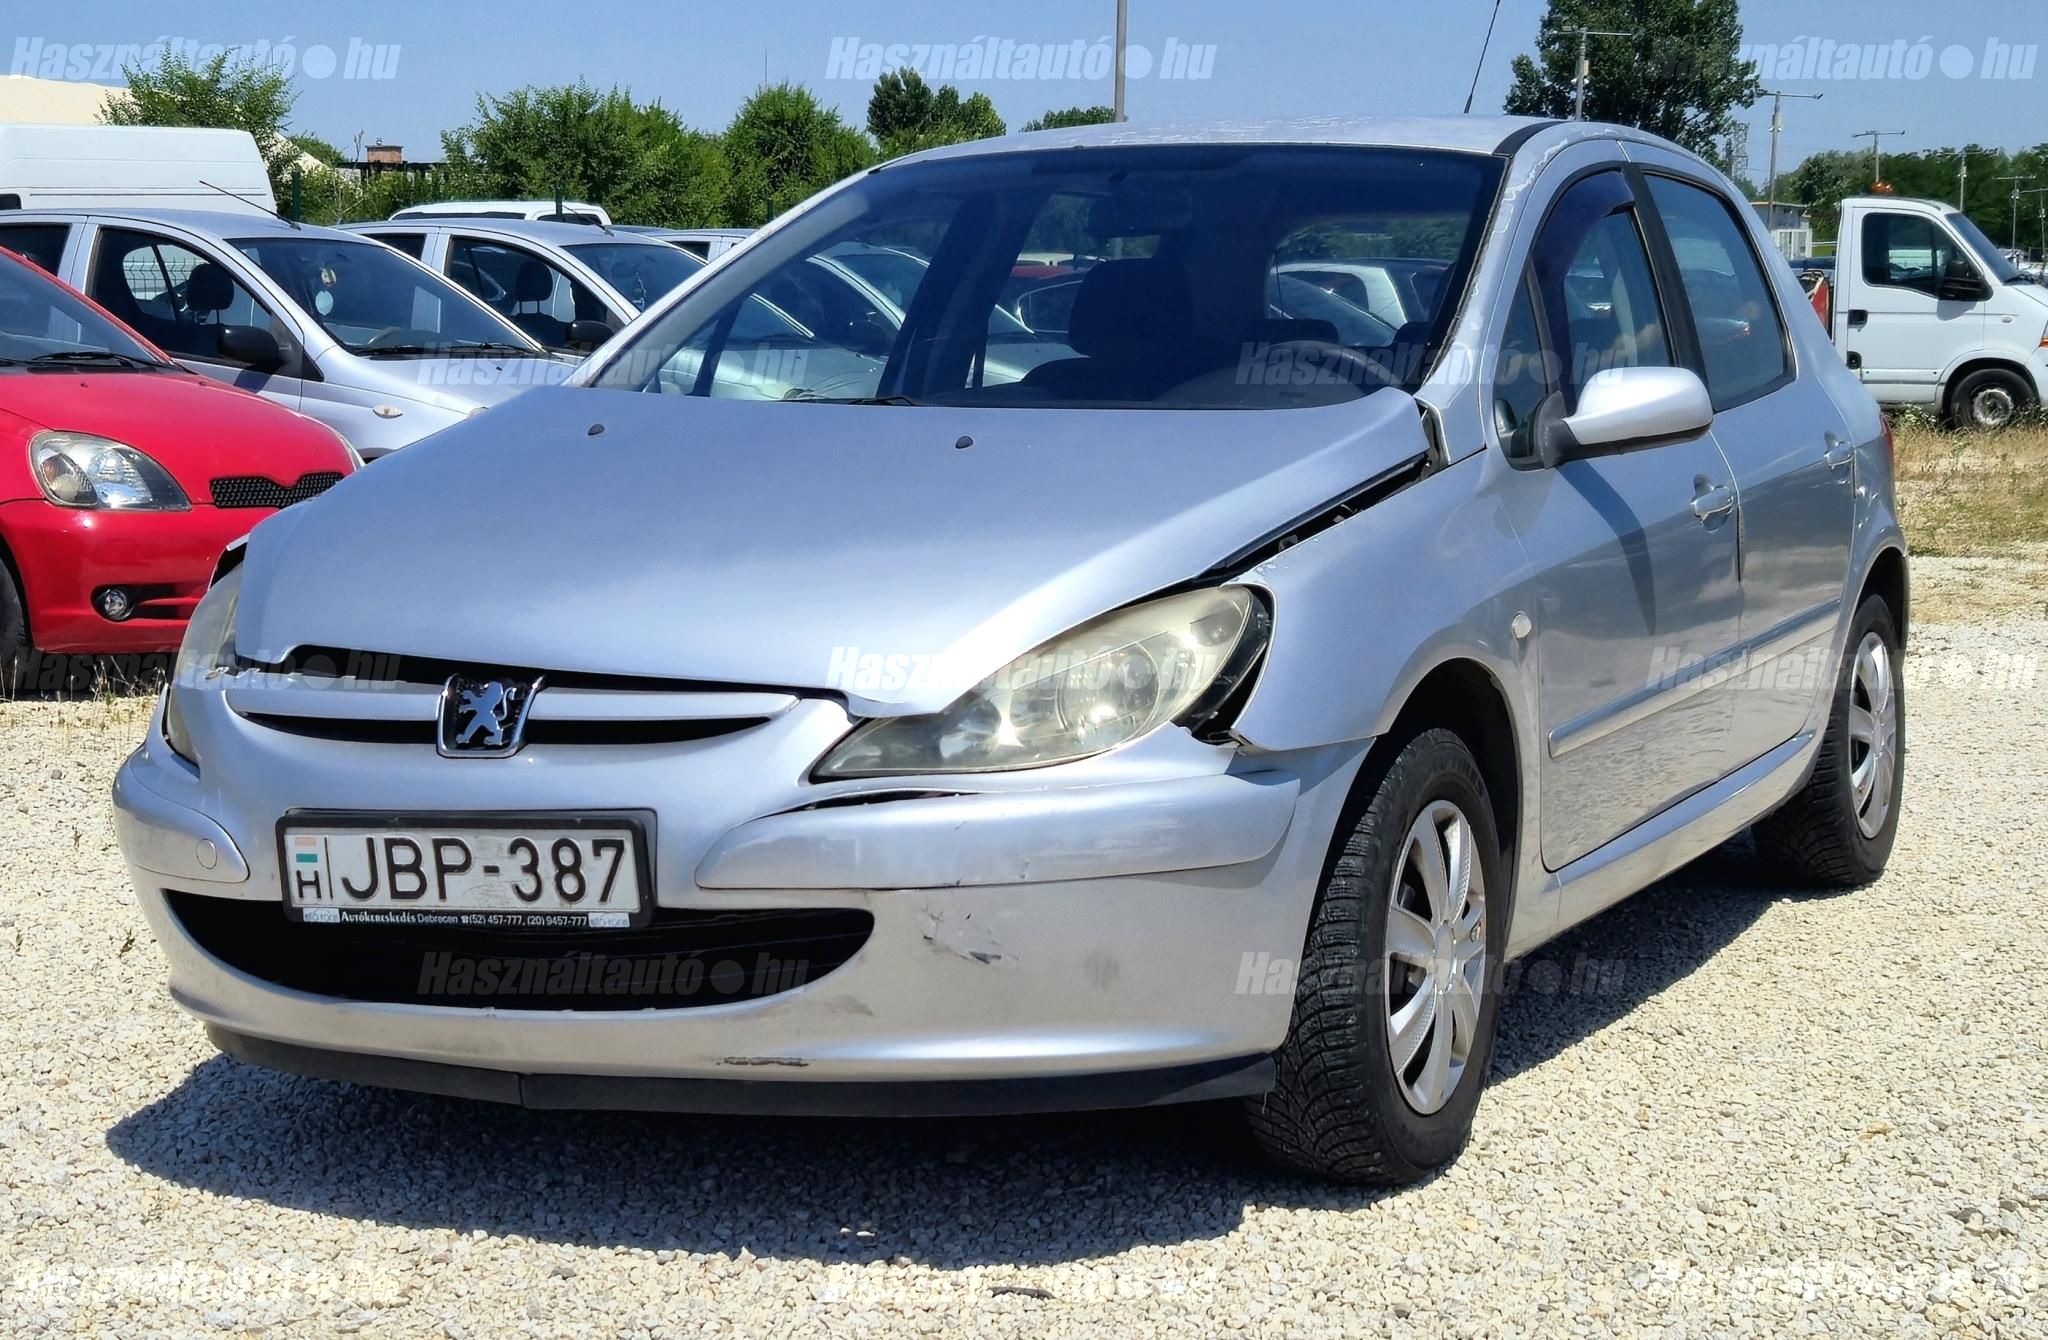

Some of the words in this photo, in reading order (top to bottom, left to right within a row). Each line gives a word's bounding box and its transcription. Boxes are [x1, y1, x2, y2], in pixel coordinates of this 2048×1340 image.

[296, 870, 321, 899] H
[341, 836, 626, 902] JBP-387
[417, 914, 459, 924] Debrecen
[527, 915, 545, 926] (20)
[546, 915, 588, 926] 9457-777
